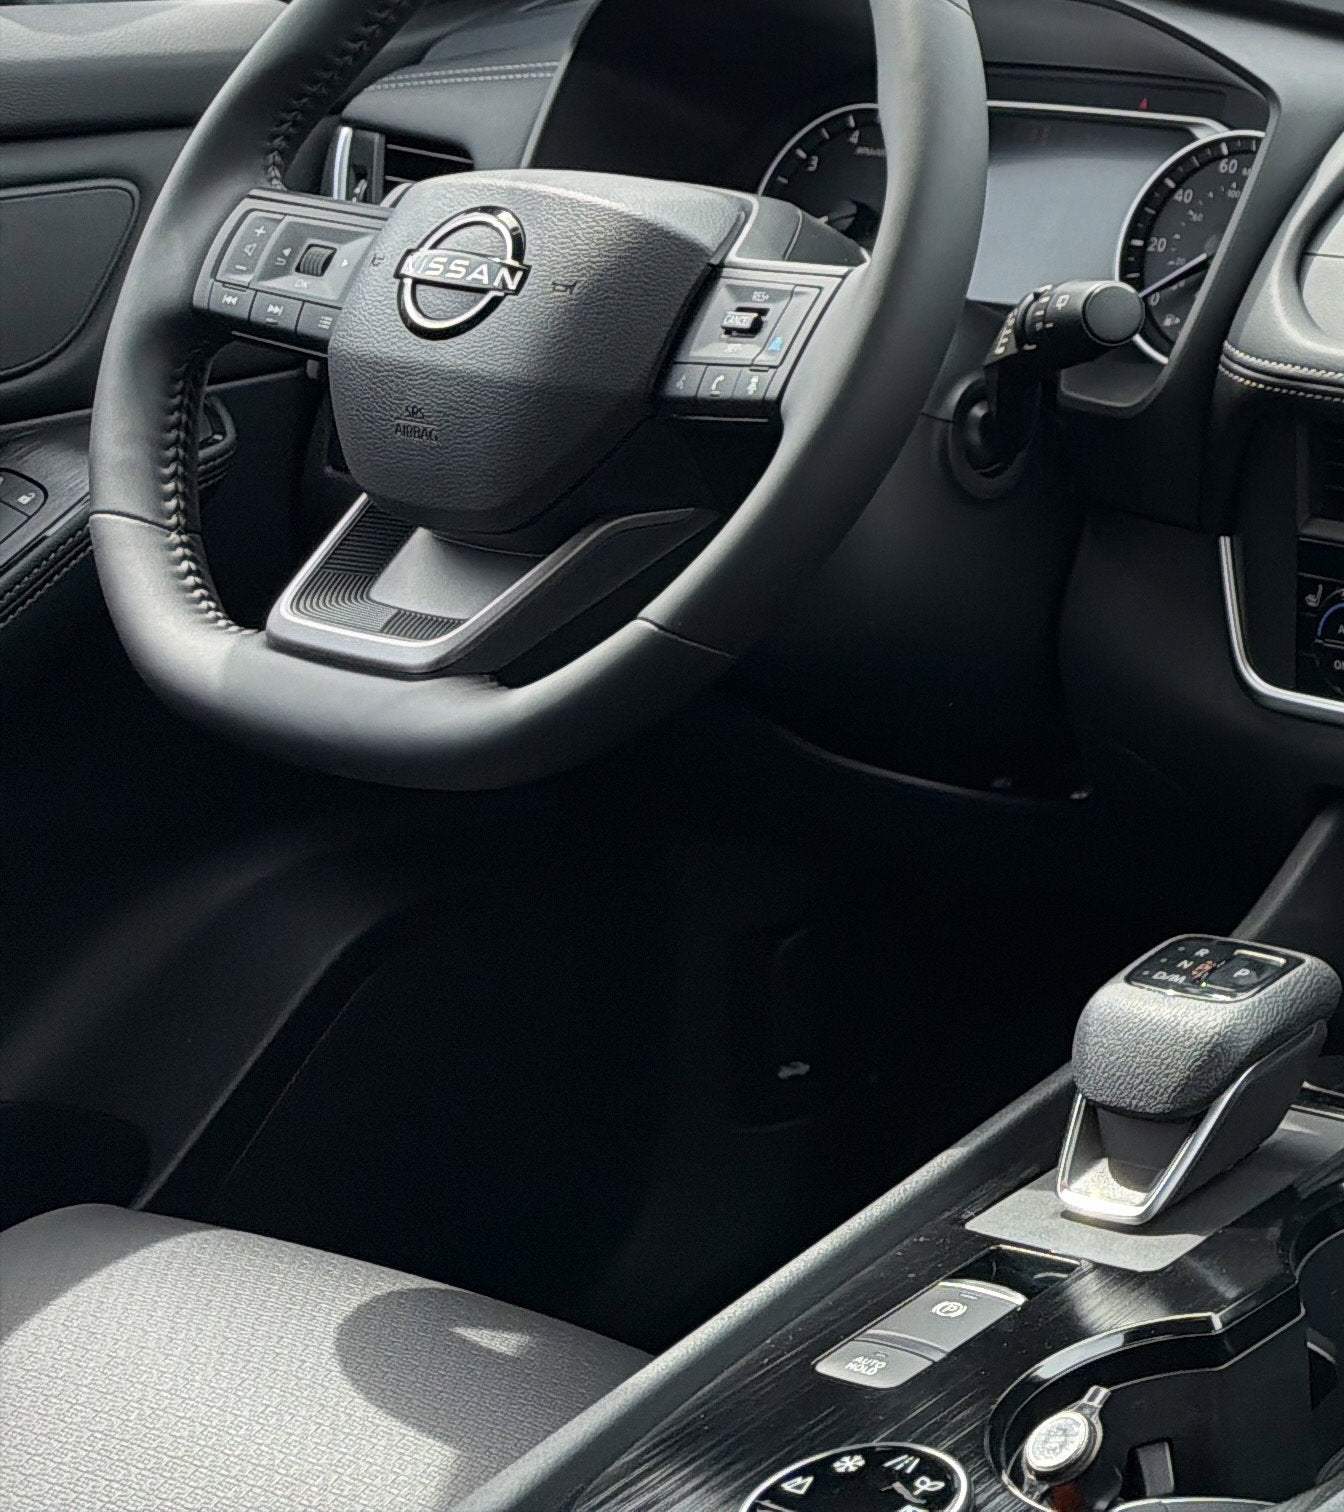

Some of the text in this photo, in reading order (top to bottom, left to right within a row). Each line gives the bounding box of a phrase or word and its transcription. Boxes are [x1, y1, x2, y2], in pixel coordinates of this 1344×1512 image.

[1220, 159, 1238, 174] 60
[1174, 188, 1193, 204] 40
[1147, 236, 1167, 253] 20
[400, 255, 523, 291] NISSAN
[1195, 948, 1210, 958] R
[1176, 959, 1194, 970] N
[1233, 968, 1250, 978] P
[845, 1362, 880, 1376] HOLD
[852, 1355, 887, 1369] AUTO
